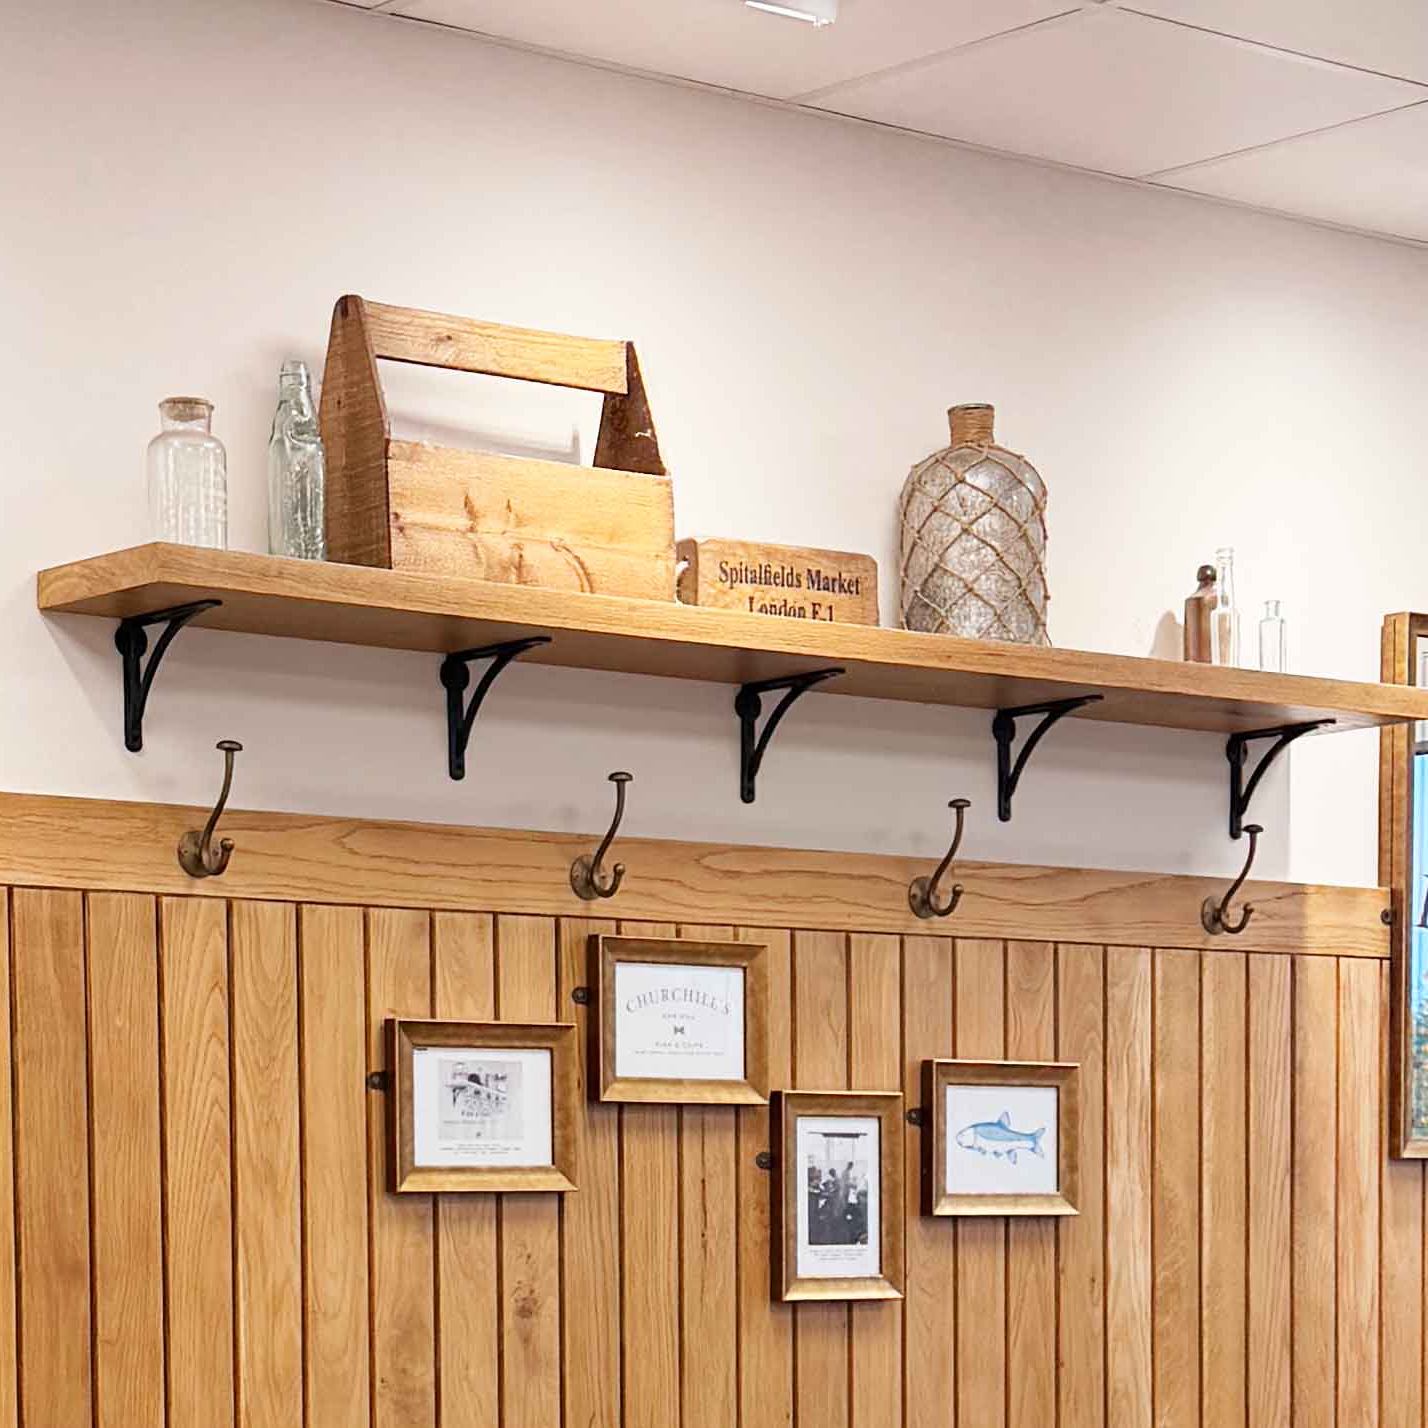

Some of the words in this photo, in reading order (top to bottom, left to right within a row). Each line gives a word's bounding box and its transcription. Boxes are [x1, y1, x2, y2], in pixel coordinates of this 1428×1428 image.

[718, 560, 802, 590] Spitalfields
[806, 568, 861, 596] Market
[748, 596, 807, 619] London
[626, 988, 732, 1016] CHURCHILL'S
